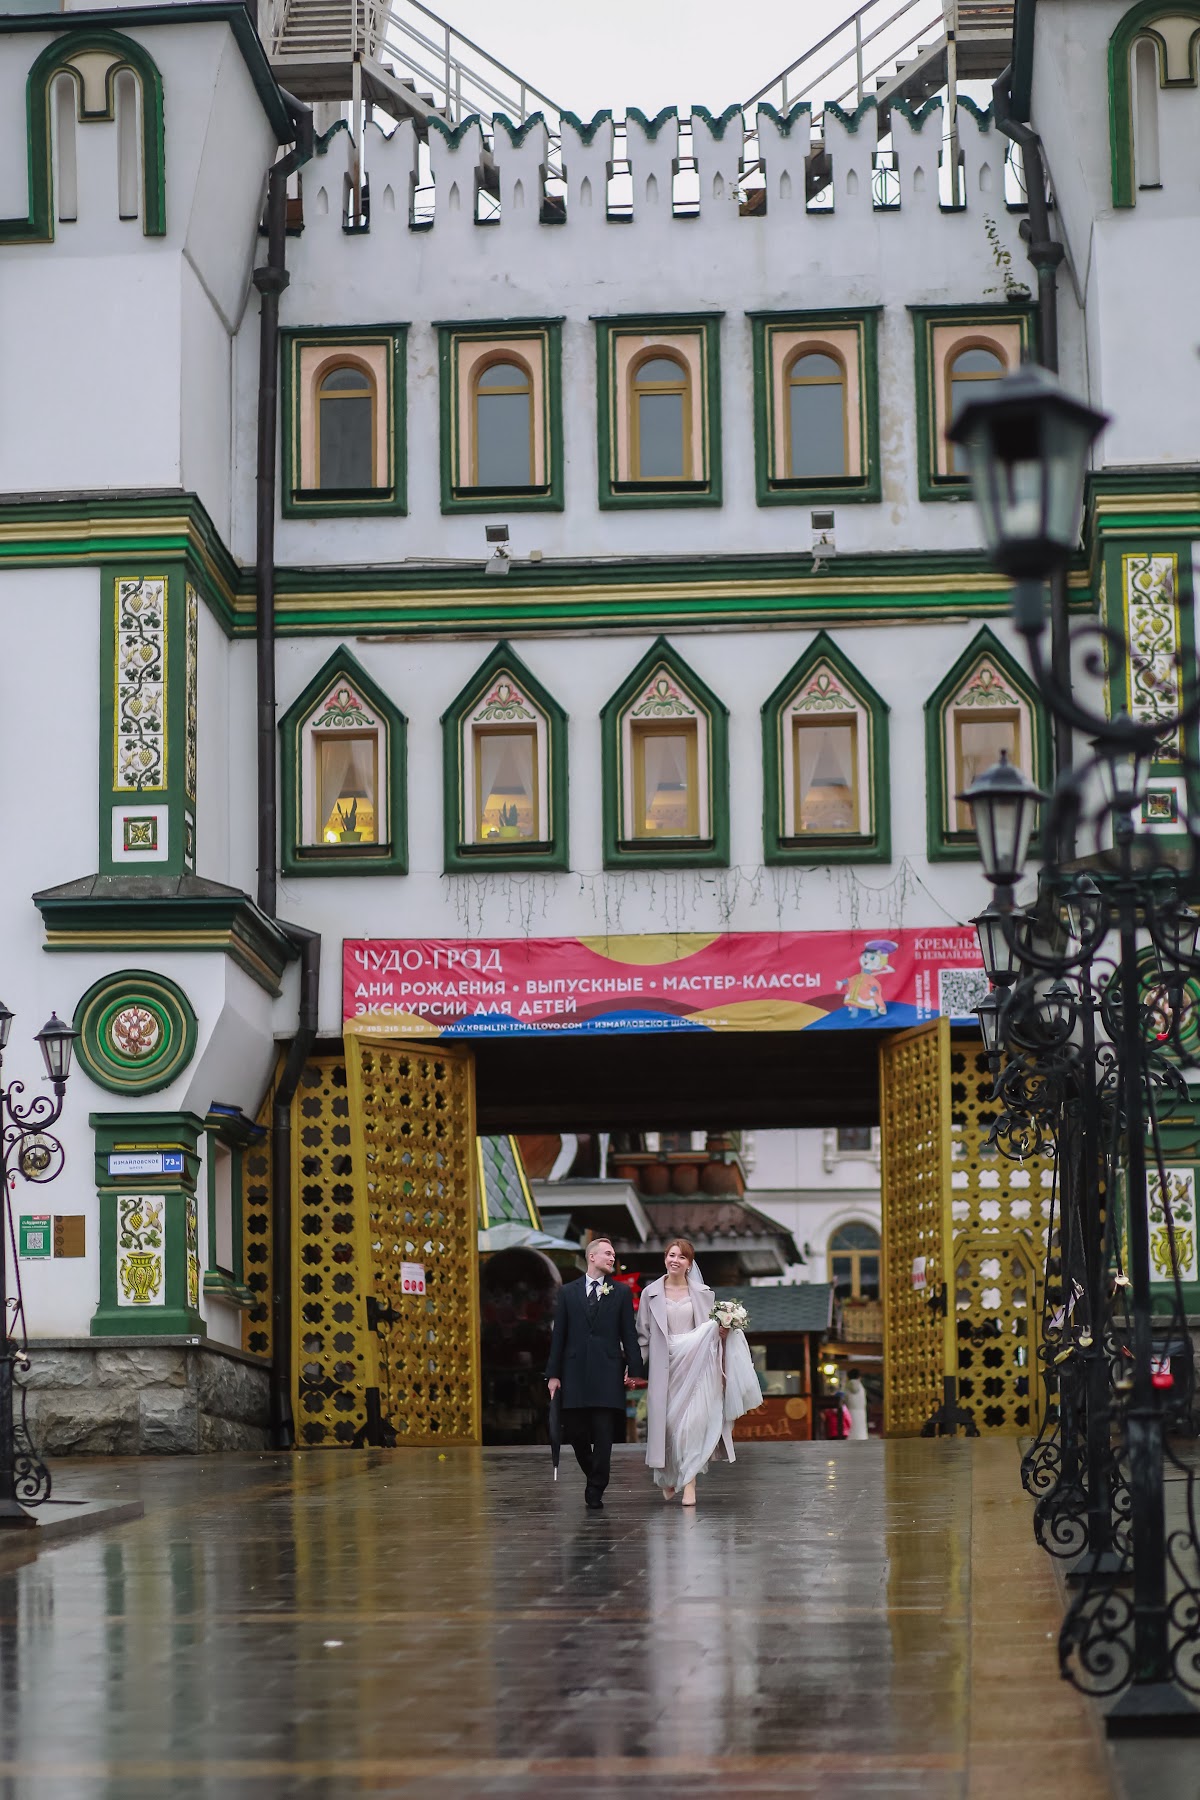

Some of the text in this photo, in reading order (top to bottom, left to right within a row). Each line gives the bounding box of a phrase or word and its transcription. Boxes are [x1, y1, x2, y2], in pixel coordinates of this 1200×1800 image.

[914, 938, 973, 950] КРЕМЛЬ
[354, 973, 821, 998] ДНИ РОЖДЕНИЯ ВЫПУСКНЫЕ МАСТЕР-КЛАССЫ
[354, 995, 577, 1017] ЭКСКУРСИИ ДЛЯ ДЕТЕЙ
[437, 1022, 583, 1032] WWW.KREMLIN-IZMAILOVO.COM
